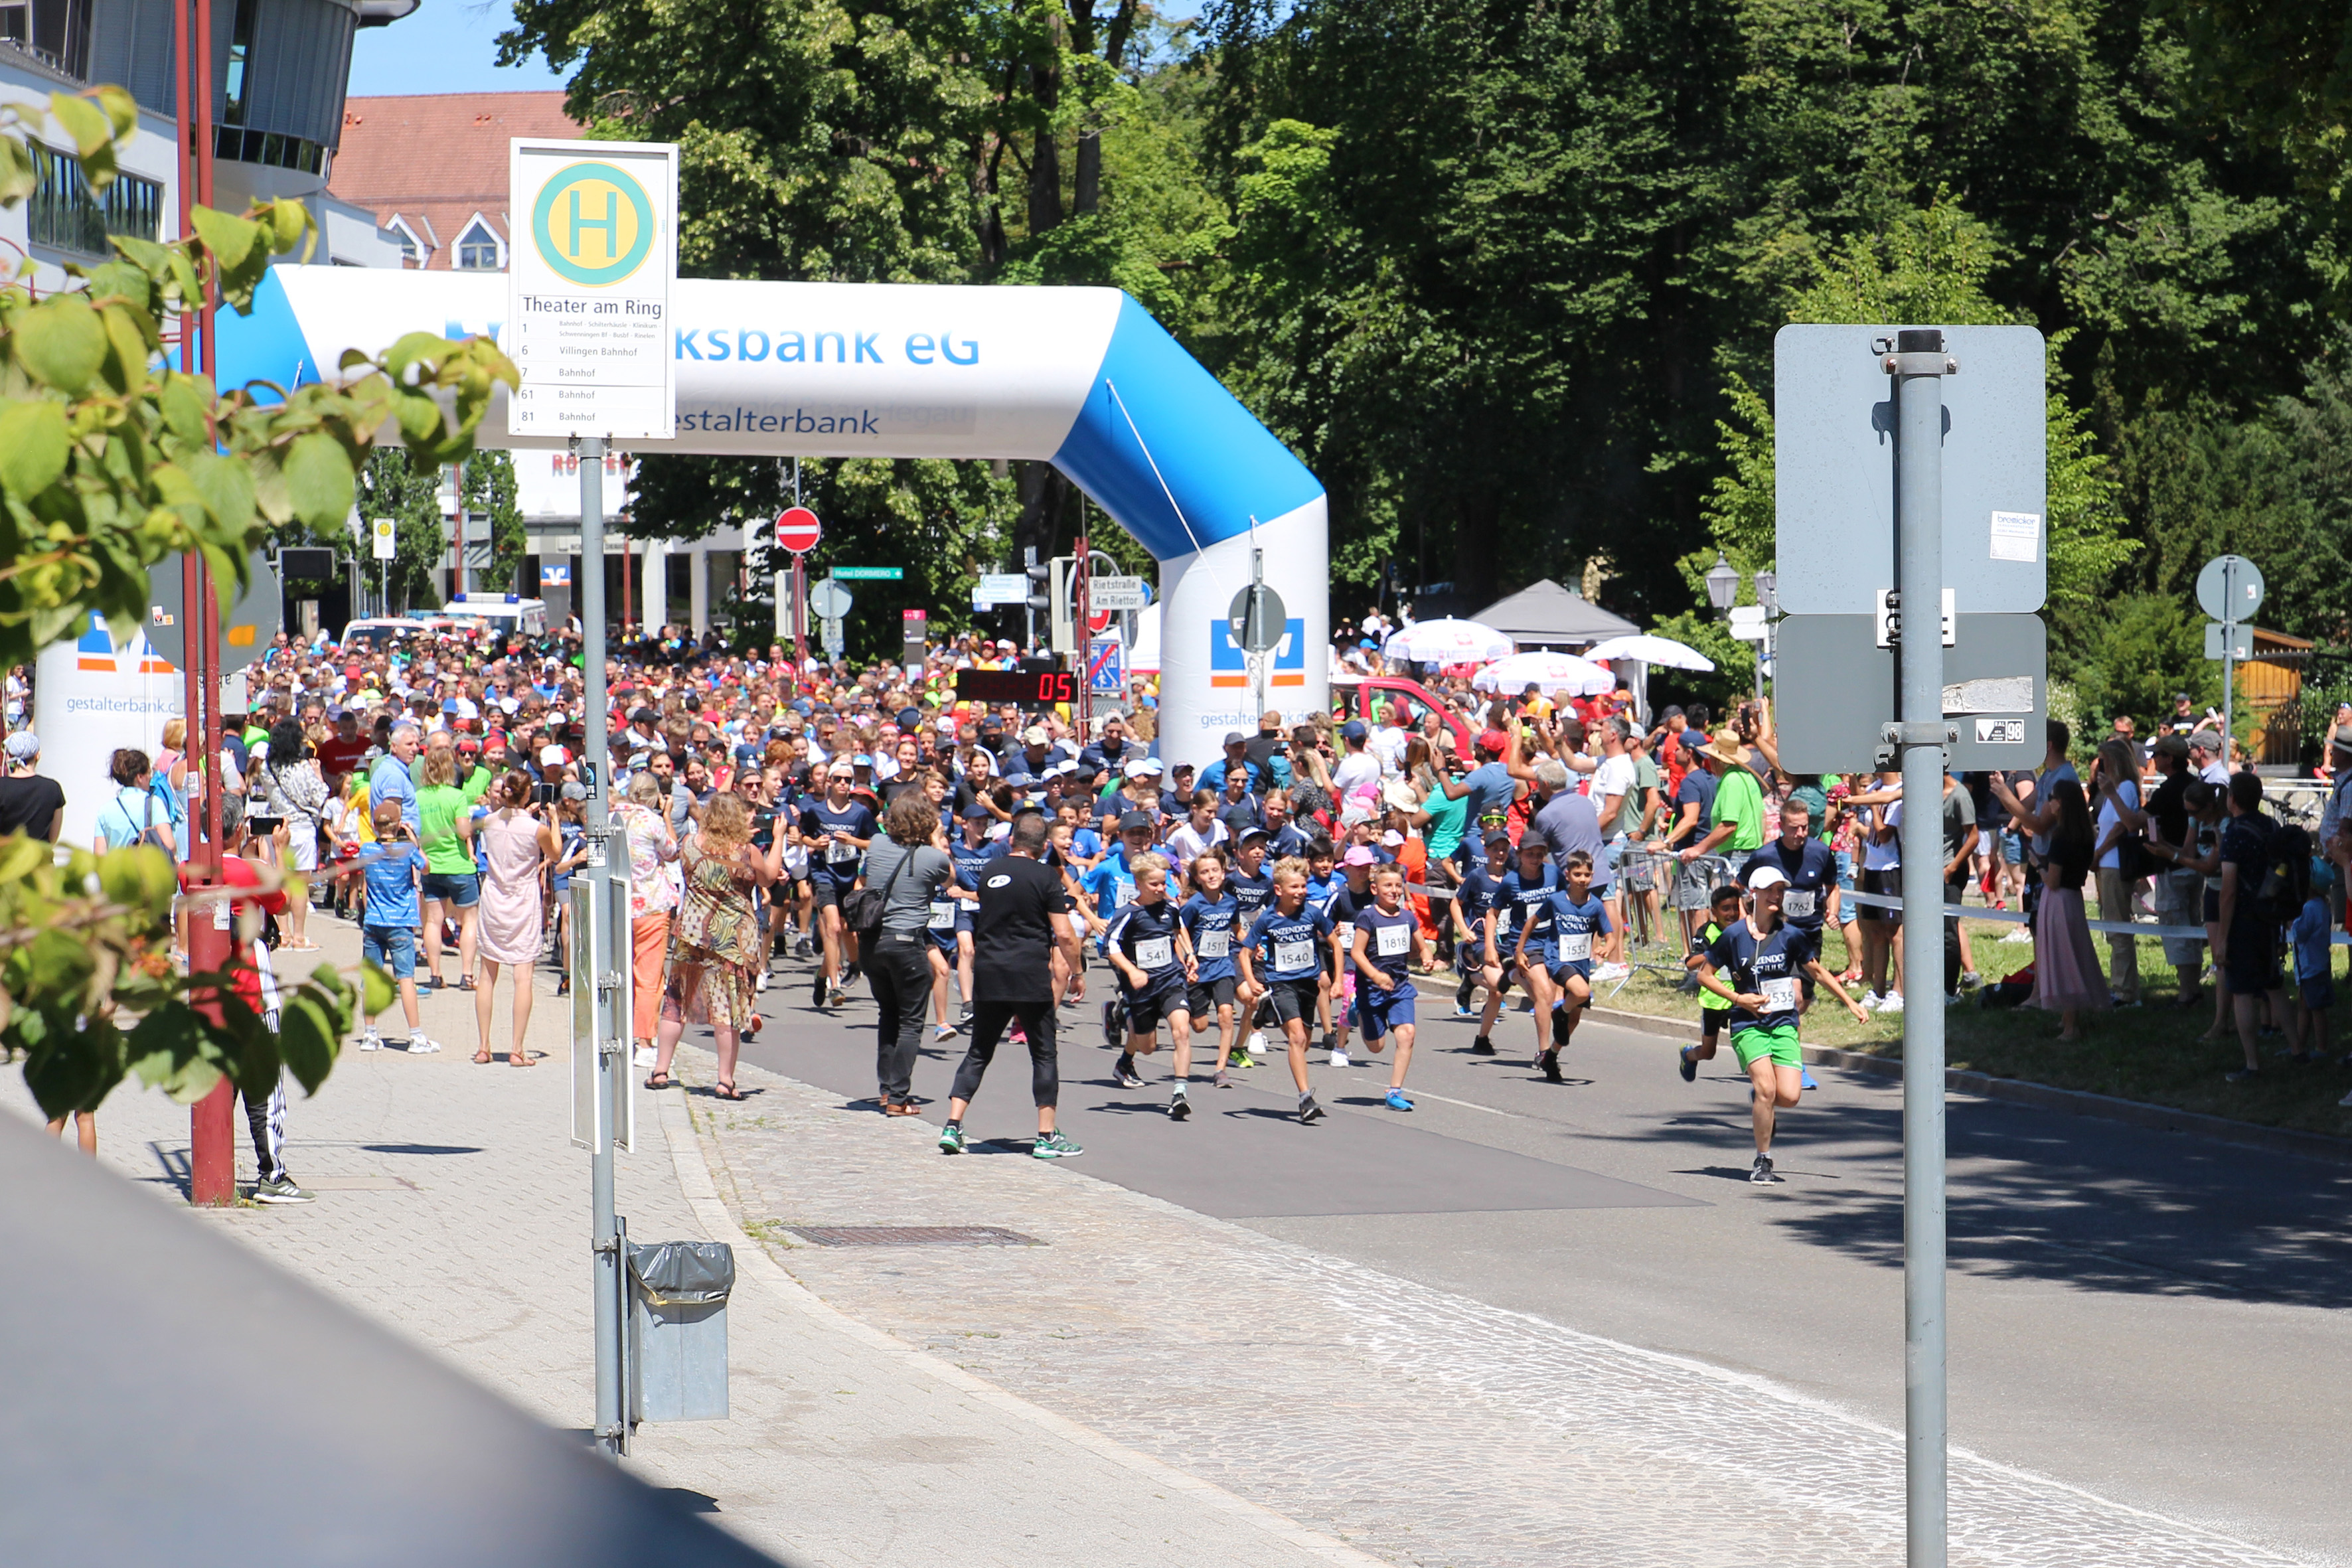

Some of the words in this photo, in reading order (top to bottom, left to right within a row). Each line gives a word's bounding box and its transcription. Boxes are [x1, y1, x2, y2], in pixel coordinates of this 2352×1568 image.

[523, 296, 587, 313] Theater
[593, 302, 618, 314] am
[625, 299, 661, 319] Ring
[522, 323, 527, 333] 1
[522, 345, 528, 355] 6
[560, 346, 597, 357] Villingen
[601, 348, 637, 356] Bahnhof
[675, 325, 884, 363] ksbank
[905, 330, 979, 366] eG
[522, 368, 527, 377] 7
[559, 368, 595, 377] Bahnhof
[521, 390, 534, 399] 61
[559, 390, 595, 399] Bahnhof
[522, 412, 534, 421] 81
[676, 407, 880, 435] stalterbank
[1997, 513, 2035, 525] bremicker
[1093, 580, 1136, 590] Rietstraße
[1110, 596, 1138, 605] Riettor
[1039, 674, 1071, 700] 05
[2007, 722, 2022, 740] 98
[1788, 902, 1810, 911] 1762
[1207, 942, 1225, 951] 1517
[1385, 937, 1407, 949] 1818
[1146, 950, 1166, 961] 541
[1567, 945, 1587, 955] 1532
[1282, 953, 1309, 965] 1540
